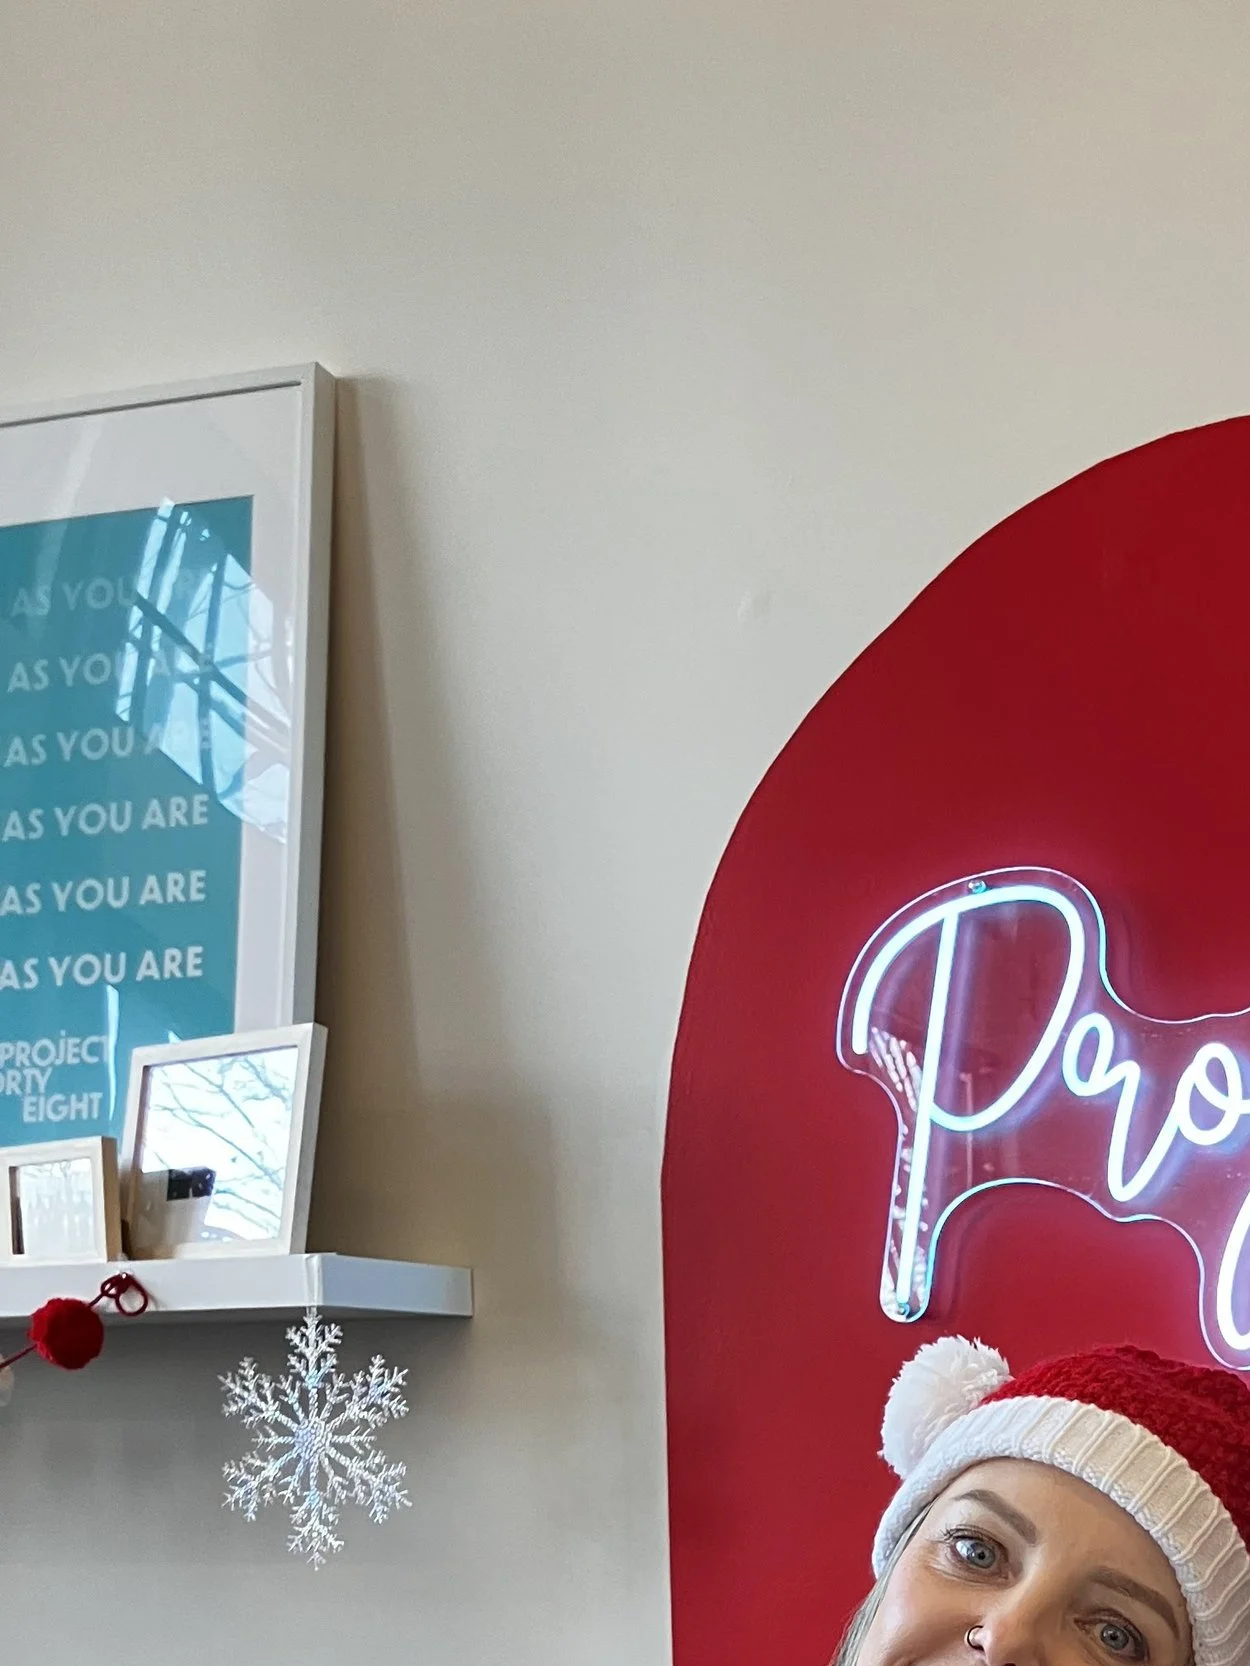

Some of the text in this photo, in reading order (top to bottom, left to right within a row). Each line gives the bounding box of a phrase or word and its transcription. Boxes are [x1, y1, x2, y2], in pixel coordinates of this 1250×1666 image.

[10, 584, 50, 618] AS
[7, 658, 50, 693] AS
[3, 733, 47, 768] AS
[56, 726, 135, 761] YOU
[2, 794, 209, 842] AS YOU ARE
[0, 869, 207, 916] AS YOU ARE
[0, 945, 203, 990] AS YOU ARE
[0, 1066, 53, 1096] RTY
[22, 1092, 103, 1123] EIGHT
